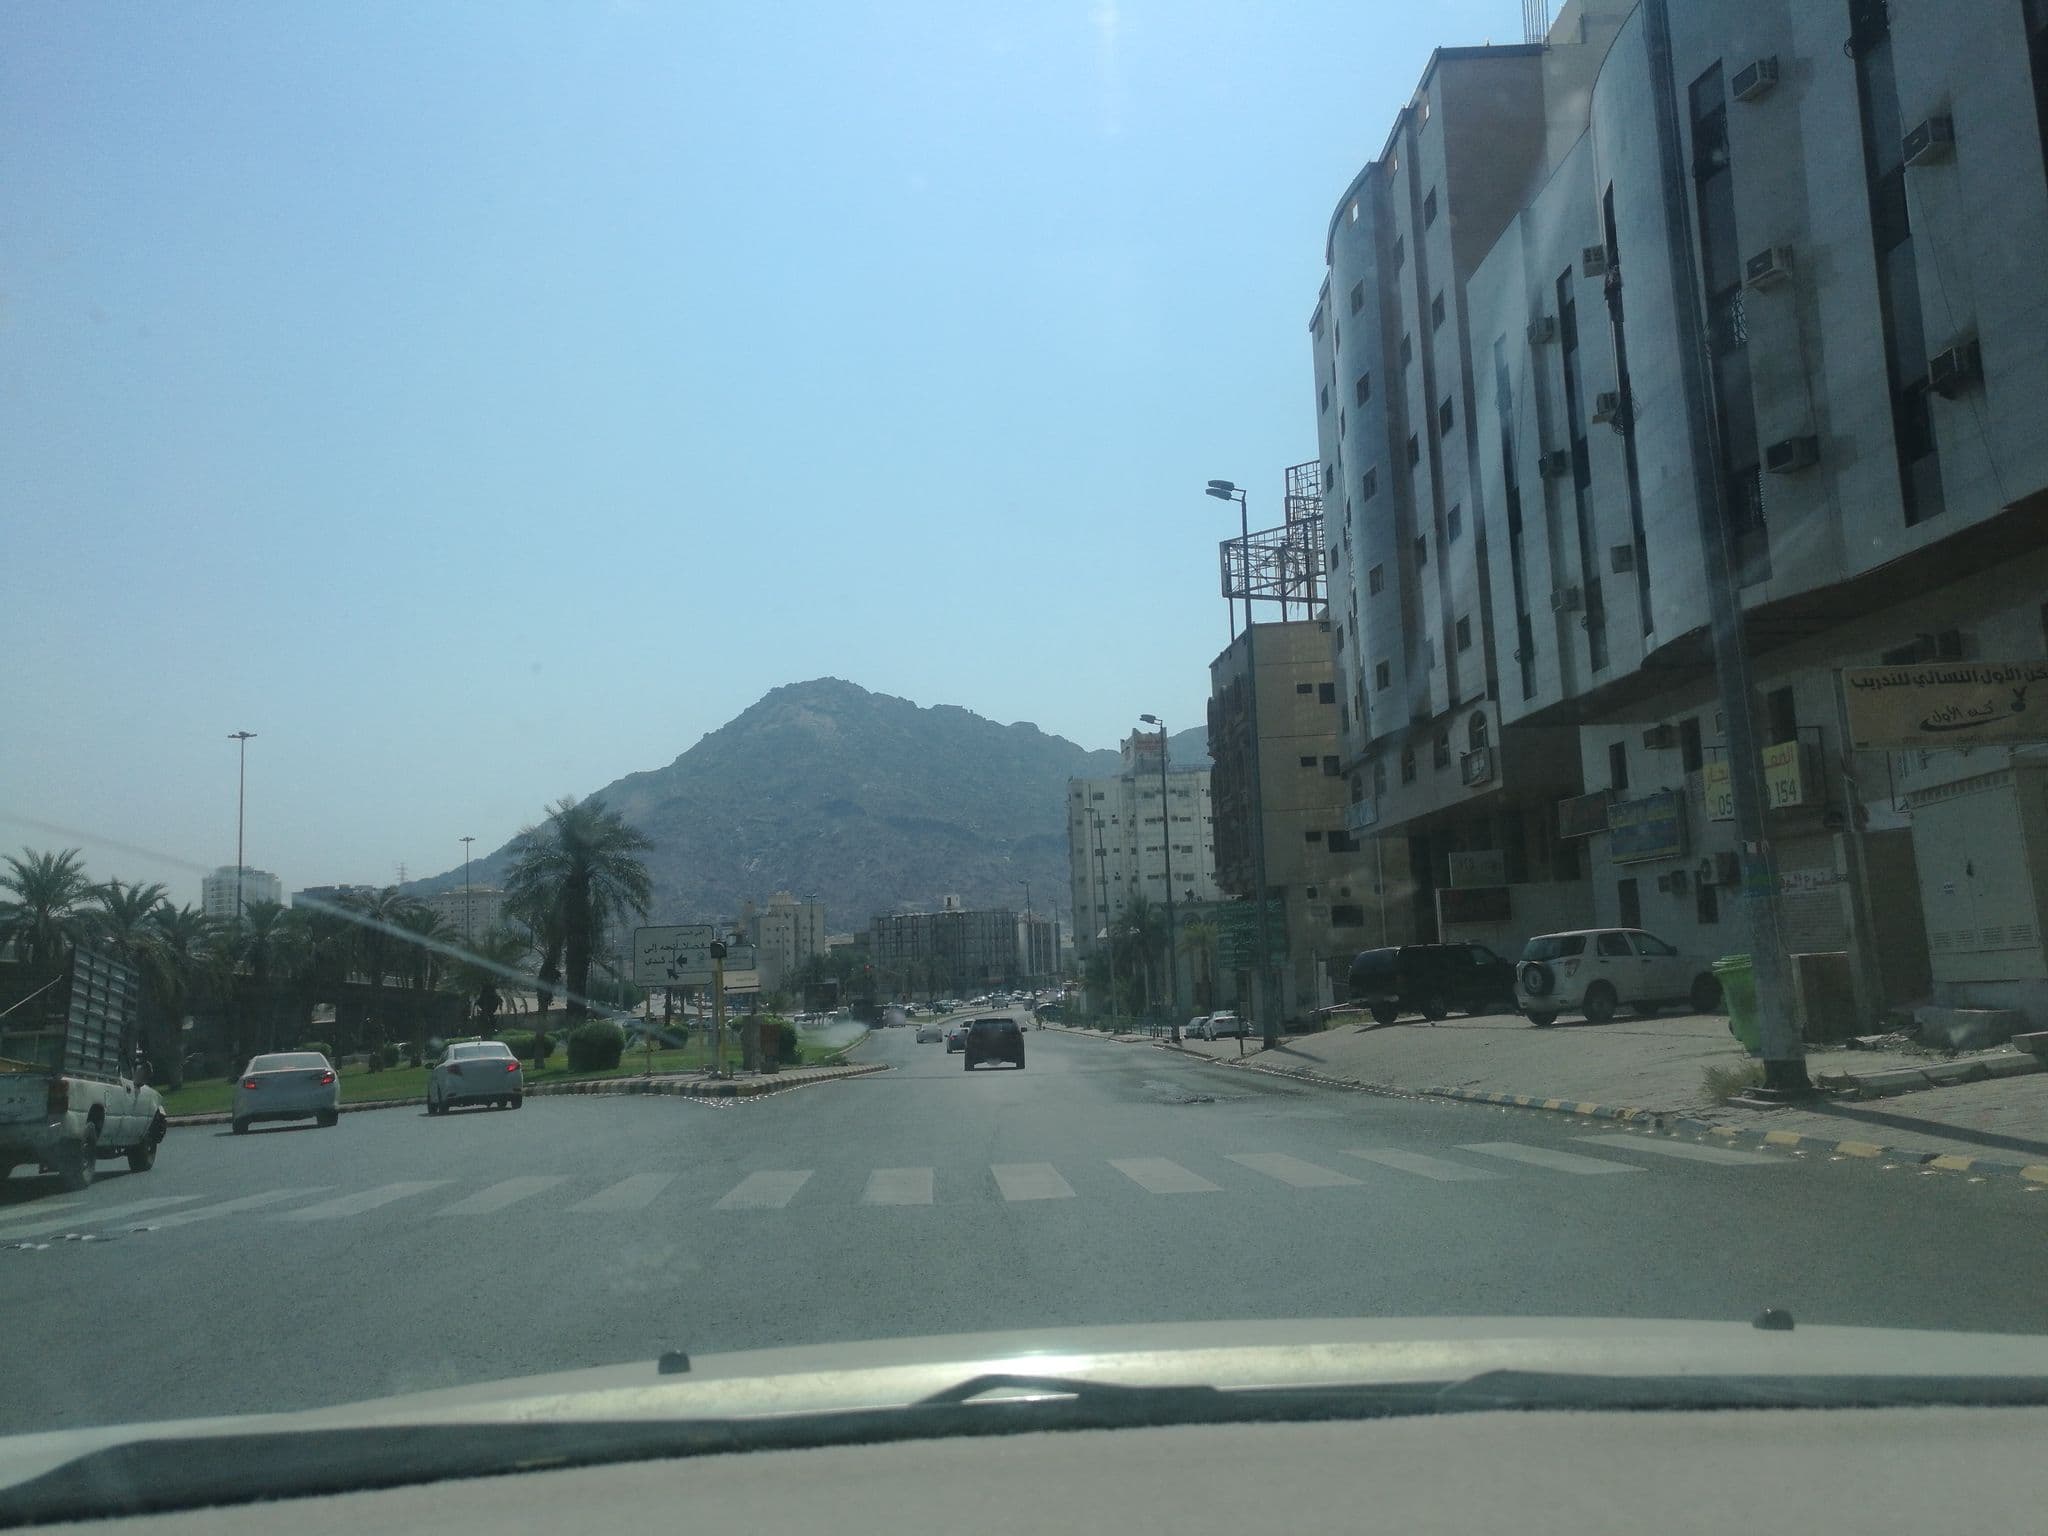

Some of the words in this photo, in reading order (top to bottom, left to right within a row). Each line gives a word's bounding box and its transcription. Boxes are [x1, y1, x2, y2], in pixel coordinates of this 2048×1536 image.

[1851, 671, 1911, 690] للتدريب
[1914, 669, 1978, 688] النسائي
[1981, 664, 2021, 685] الأول
